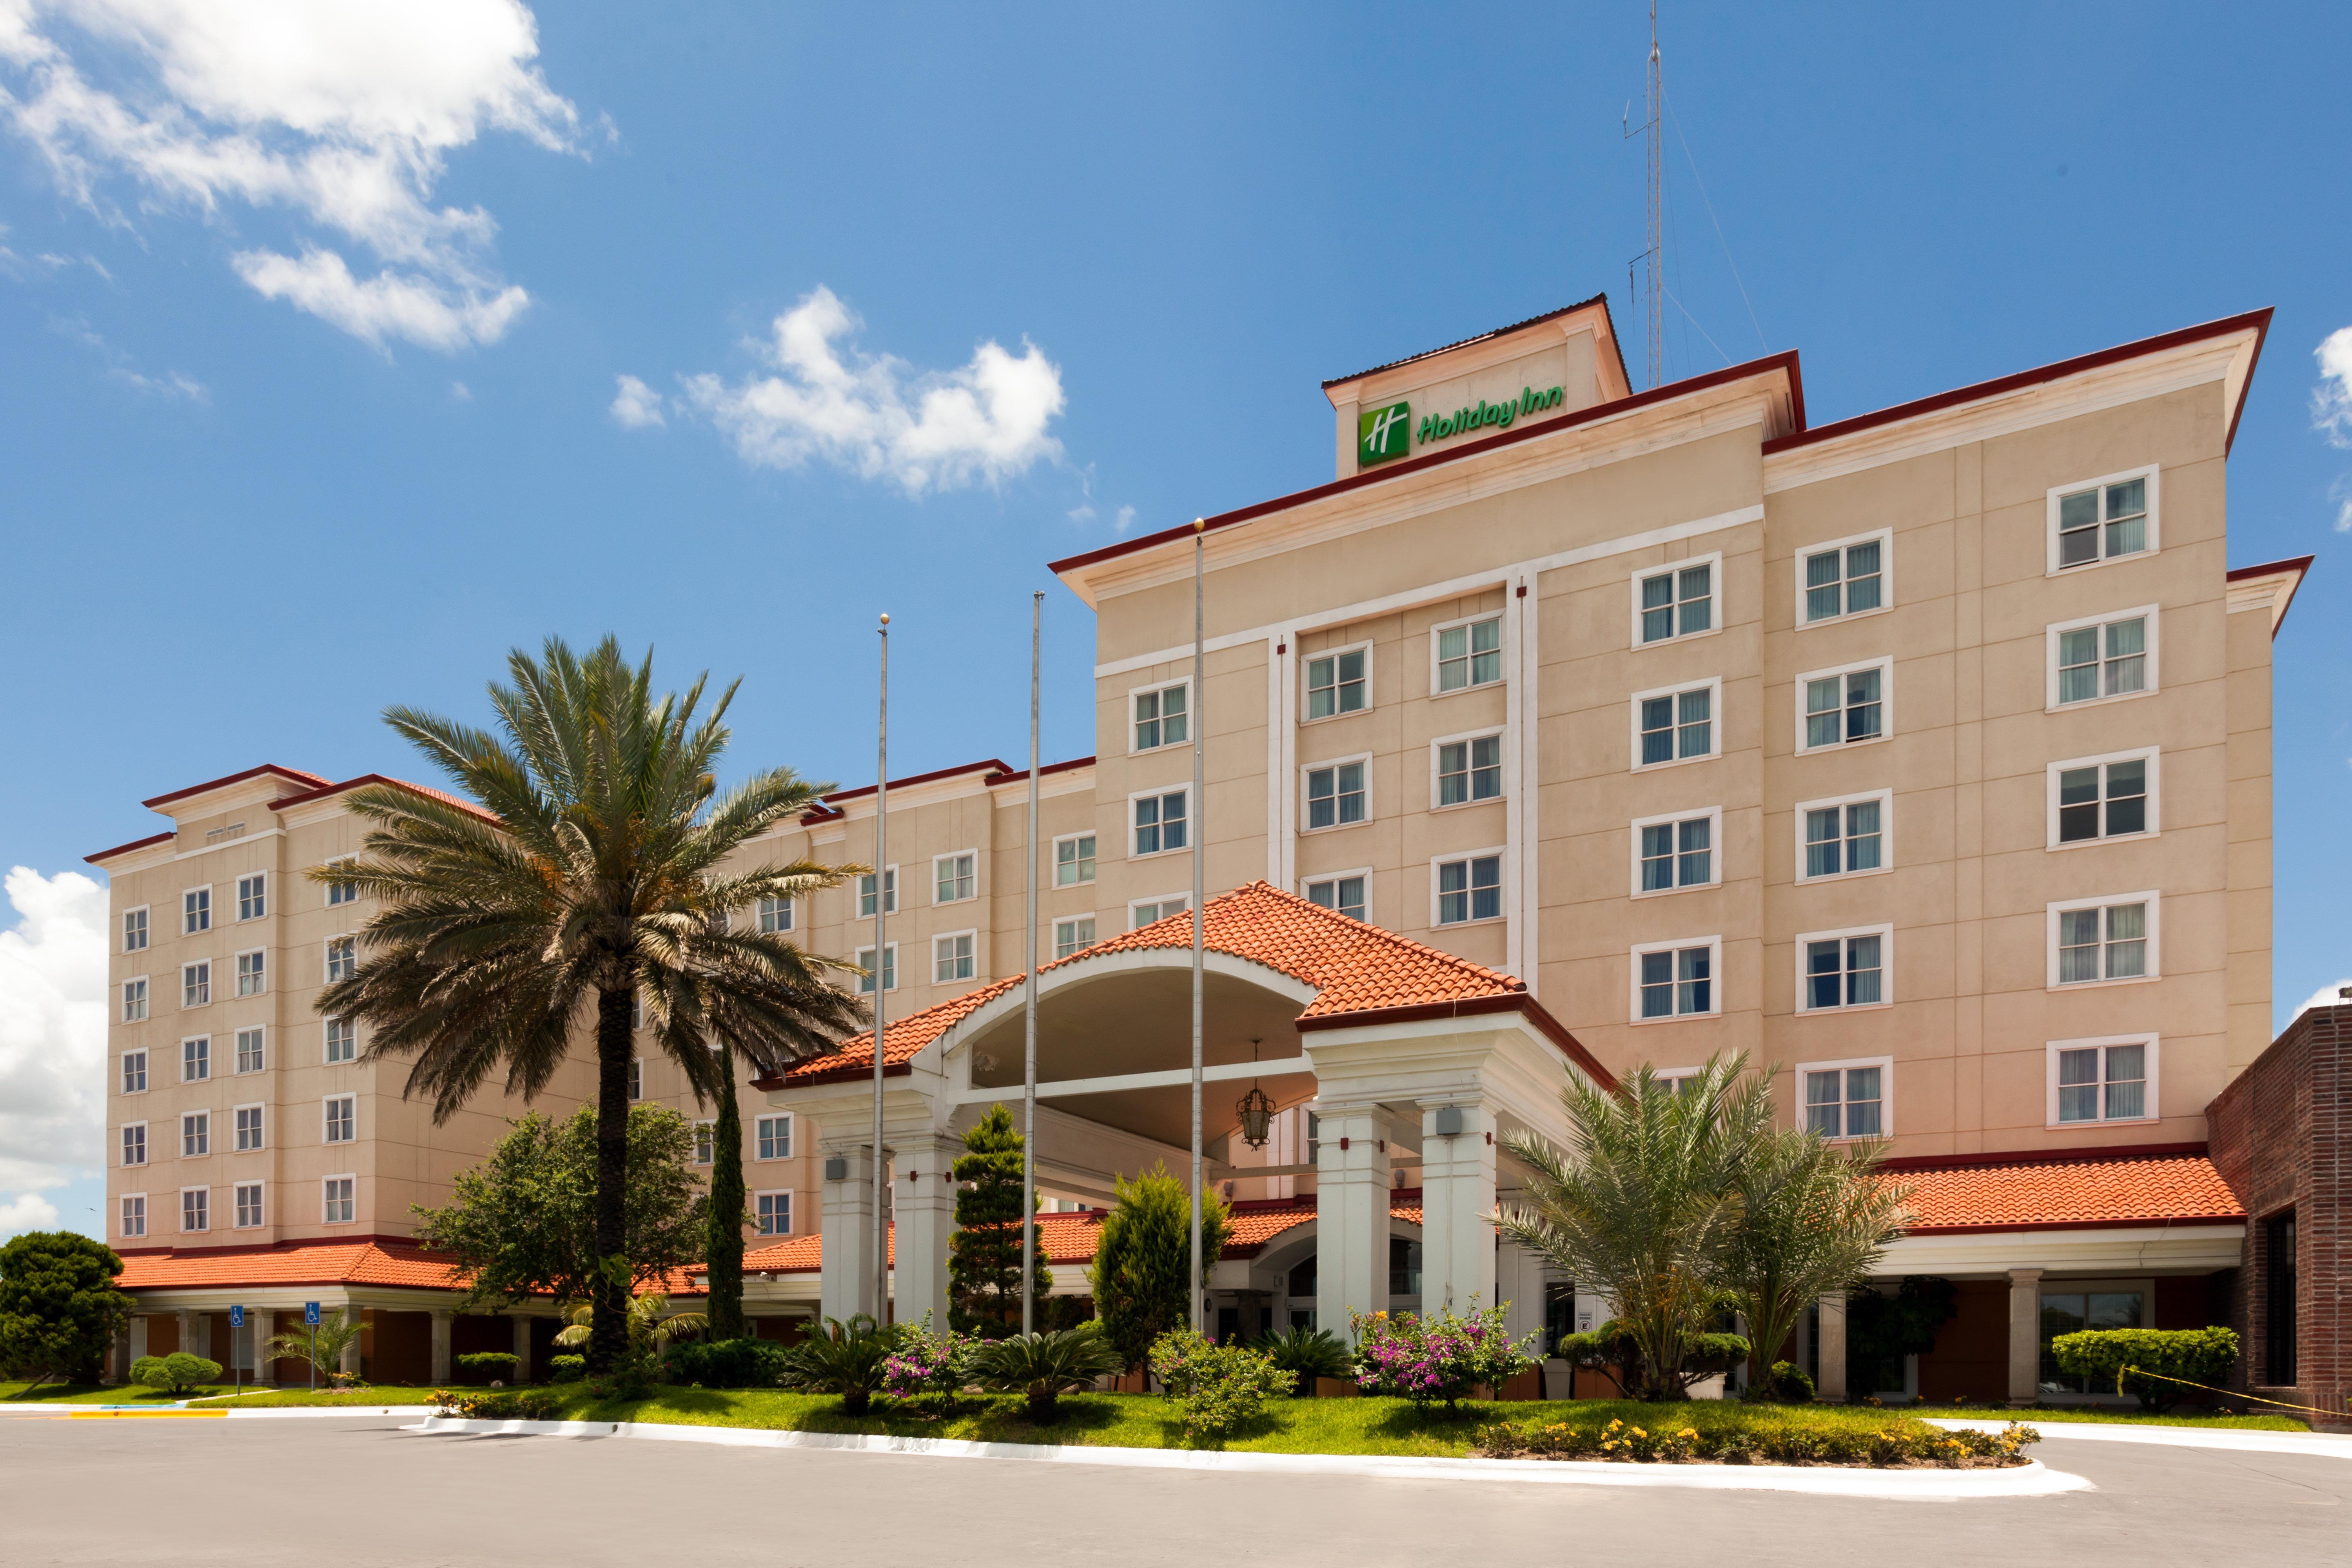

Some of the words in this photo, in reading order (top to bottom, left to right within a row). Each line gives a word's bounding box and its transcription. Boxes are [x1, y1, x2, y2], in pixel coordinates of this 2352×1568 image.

[1365, 407, 1407, 453] H
[1417, 399, 1517, 444] Holiday
[1520, 387, 1562, 416] Inn
